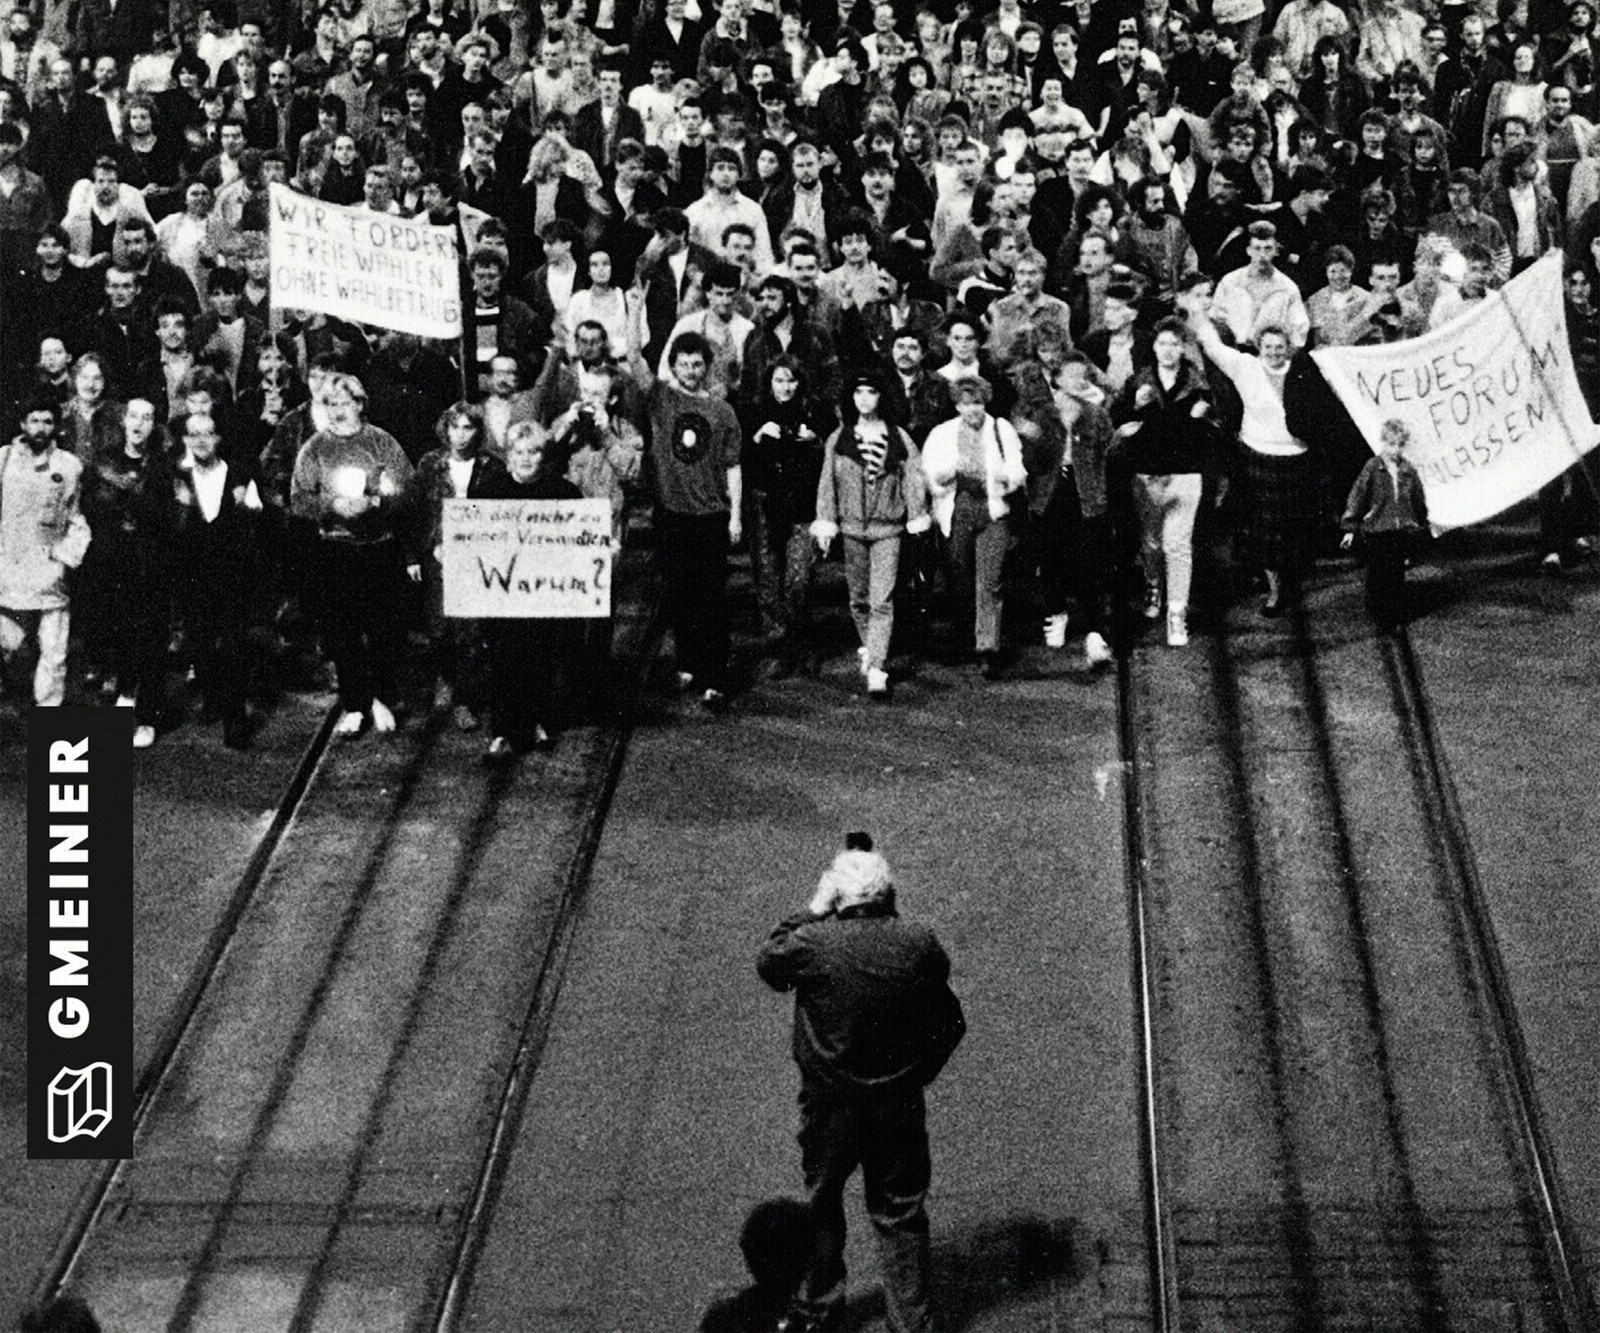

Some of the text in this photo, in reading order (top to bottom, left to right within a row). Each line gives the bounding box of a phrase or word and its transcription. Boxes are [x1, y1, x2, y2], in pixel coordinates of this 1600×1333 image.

[275, 196, 328, 233] WIR
[276, 266, 330, 298] OHNE
[284, 230, 444, 288] FREIE WAHLEN
[1357, 346, 1475, 406] NEUES
[1429, 340, 1559, 439] FORUM
[477, 553, 605, 606] Warum?
